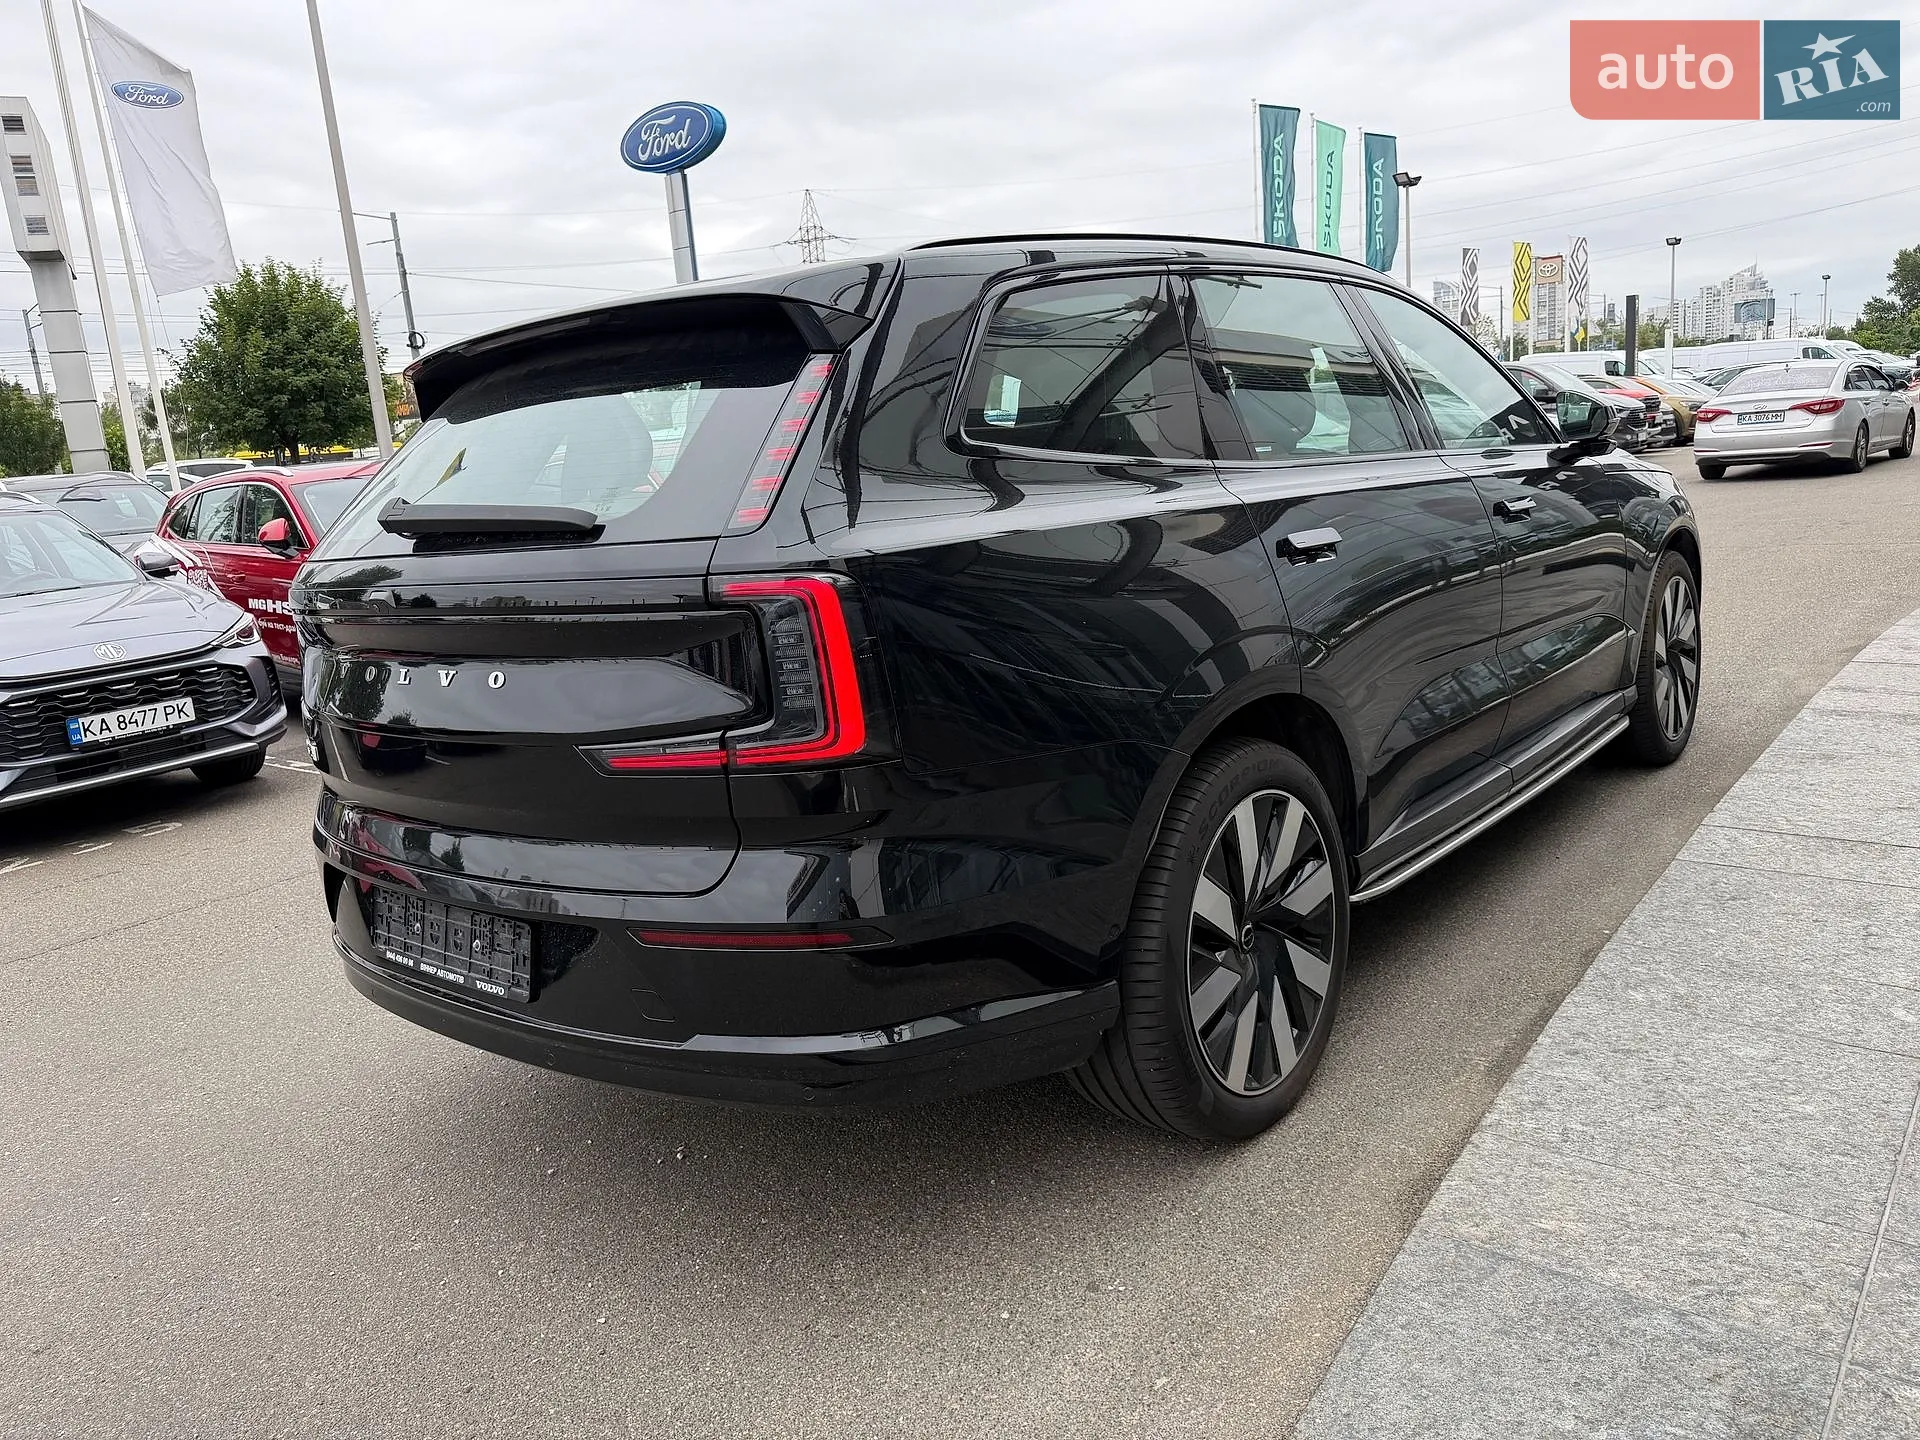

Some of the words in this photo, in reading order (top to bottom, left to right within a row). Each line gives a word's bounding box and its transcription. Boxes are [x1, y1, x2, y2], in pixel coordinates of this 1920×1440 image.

[124, 84, 169, 106] Ford
[637, 114, 691, 162] Ford
[96, 643, 125, 660] MG
[339, 662, 507, 689] VOLVO
[81, 717, 112, 739] KA
[116, 707, 158, 731] 8477
[163, 701, 190, 722] PK
[71, 733, 82, 741] UA
[475, 980, 505, 996] VOLVO
